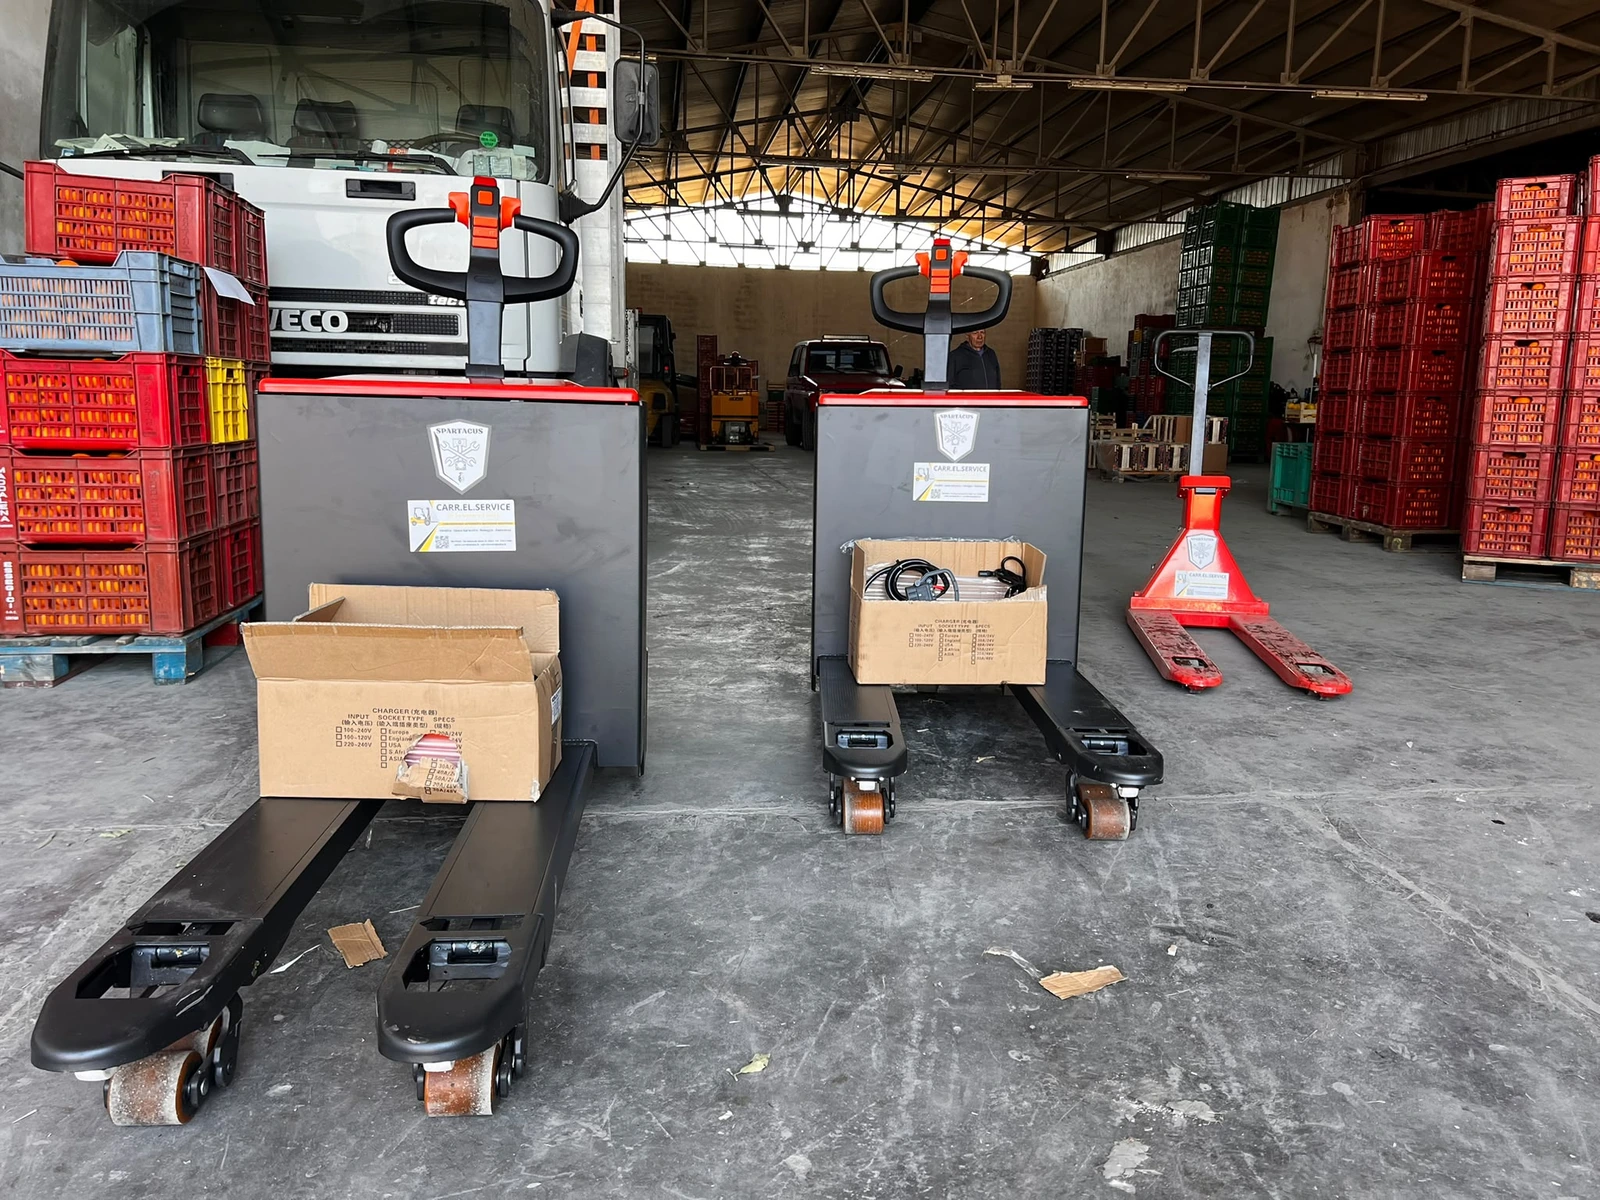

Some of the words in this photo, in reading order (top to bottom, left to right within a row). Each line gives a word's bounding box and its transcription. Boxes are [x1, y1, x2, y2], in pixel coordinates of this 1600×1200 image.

[435, 427, 484, 435] SPARTACUS
[436, 503, 511, 511] CARR.EL.SERVICE
[372, 707, 410, 715] CHARGER
